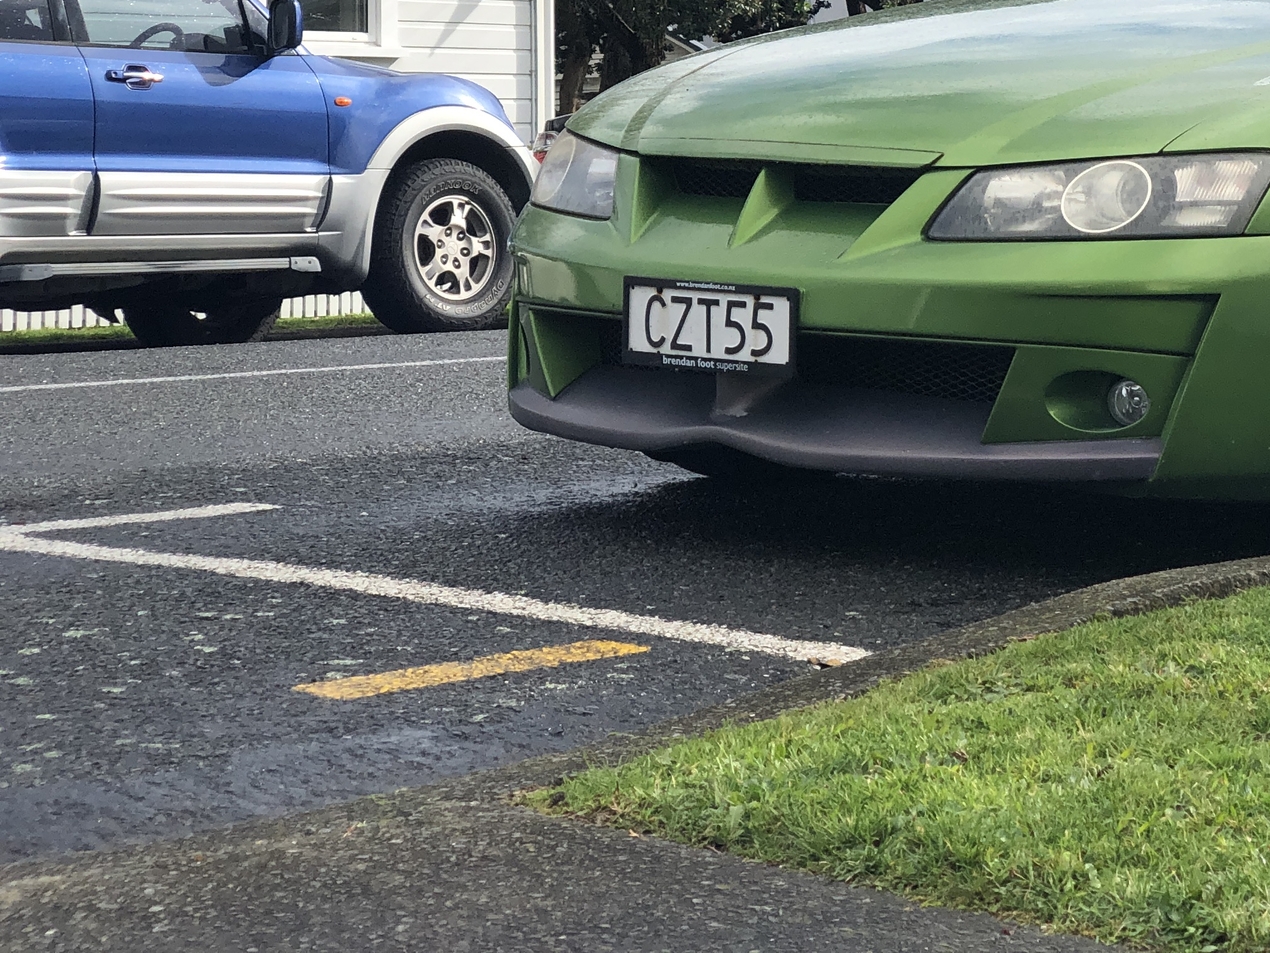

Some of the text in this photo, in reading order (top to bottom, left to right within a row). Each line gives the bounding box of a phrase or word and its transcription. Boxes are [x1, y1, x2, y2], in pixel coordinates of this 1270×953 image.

[676, 281, 736, 291] www.brendanfoot.co.nz
[645, 294, 774, 357] CZT55
[662, 355, 749, 372] brendan foot supersite
